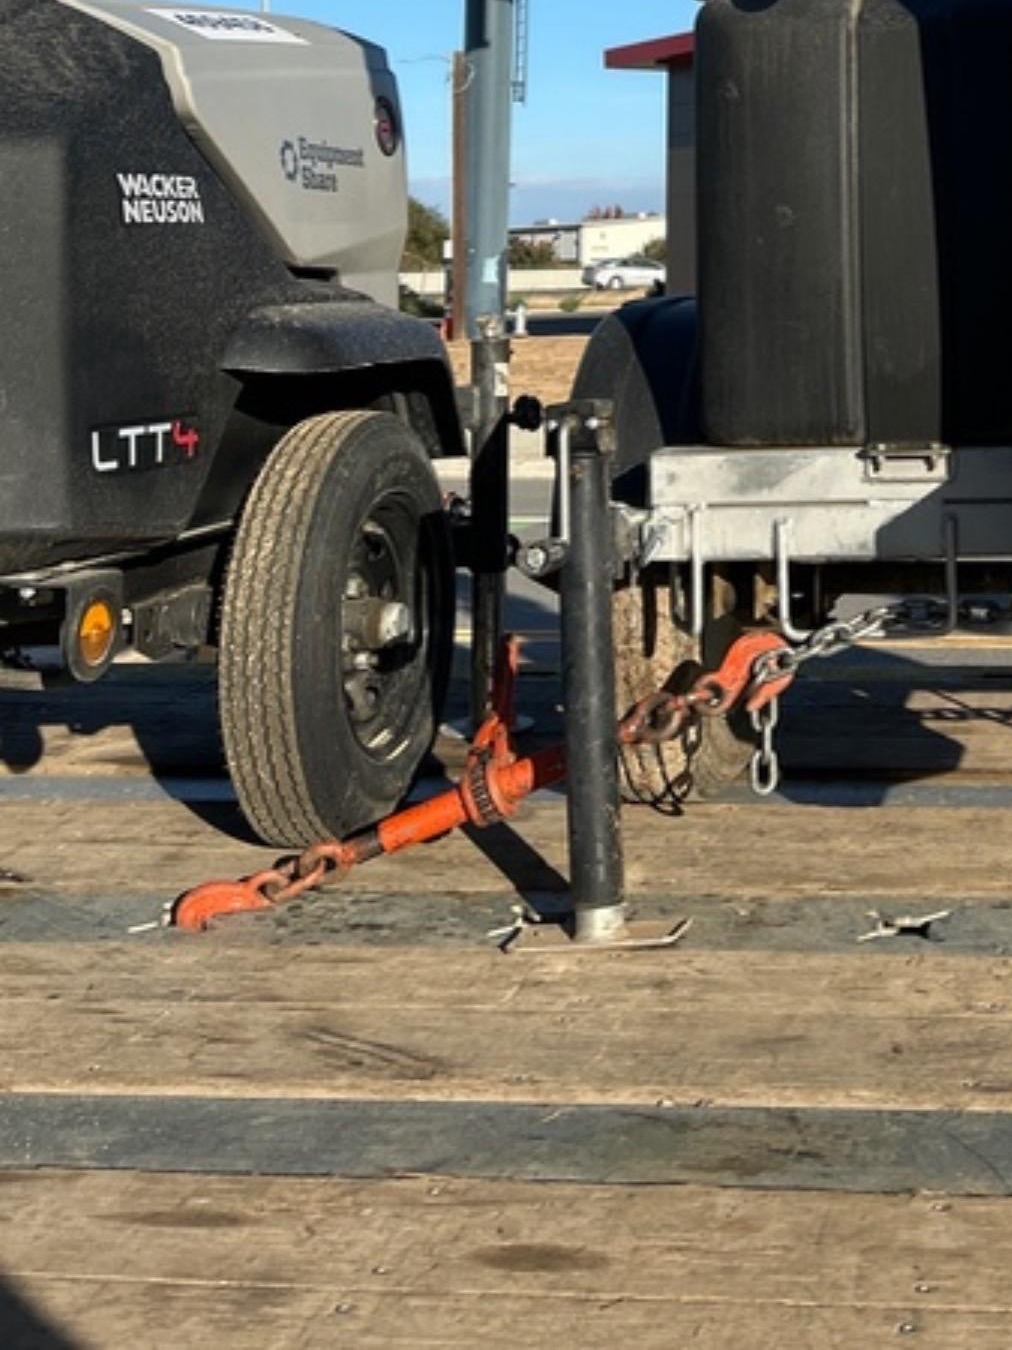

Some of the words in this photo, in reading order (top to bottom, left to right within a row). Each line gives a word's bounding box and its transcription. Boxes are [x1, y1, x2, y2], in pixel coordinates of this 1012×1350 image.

[297, 136, 365, 169] Equipment
[116, 173, 200, 199] WACKER
[302, 166, 339, 192] Share
[121, 199, 205, 224] NEUSON
[91, 419, 200, 472] LTT4
